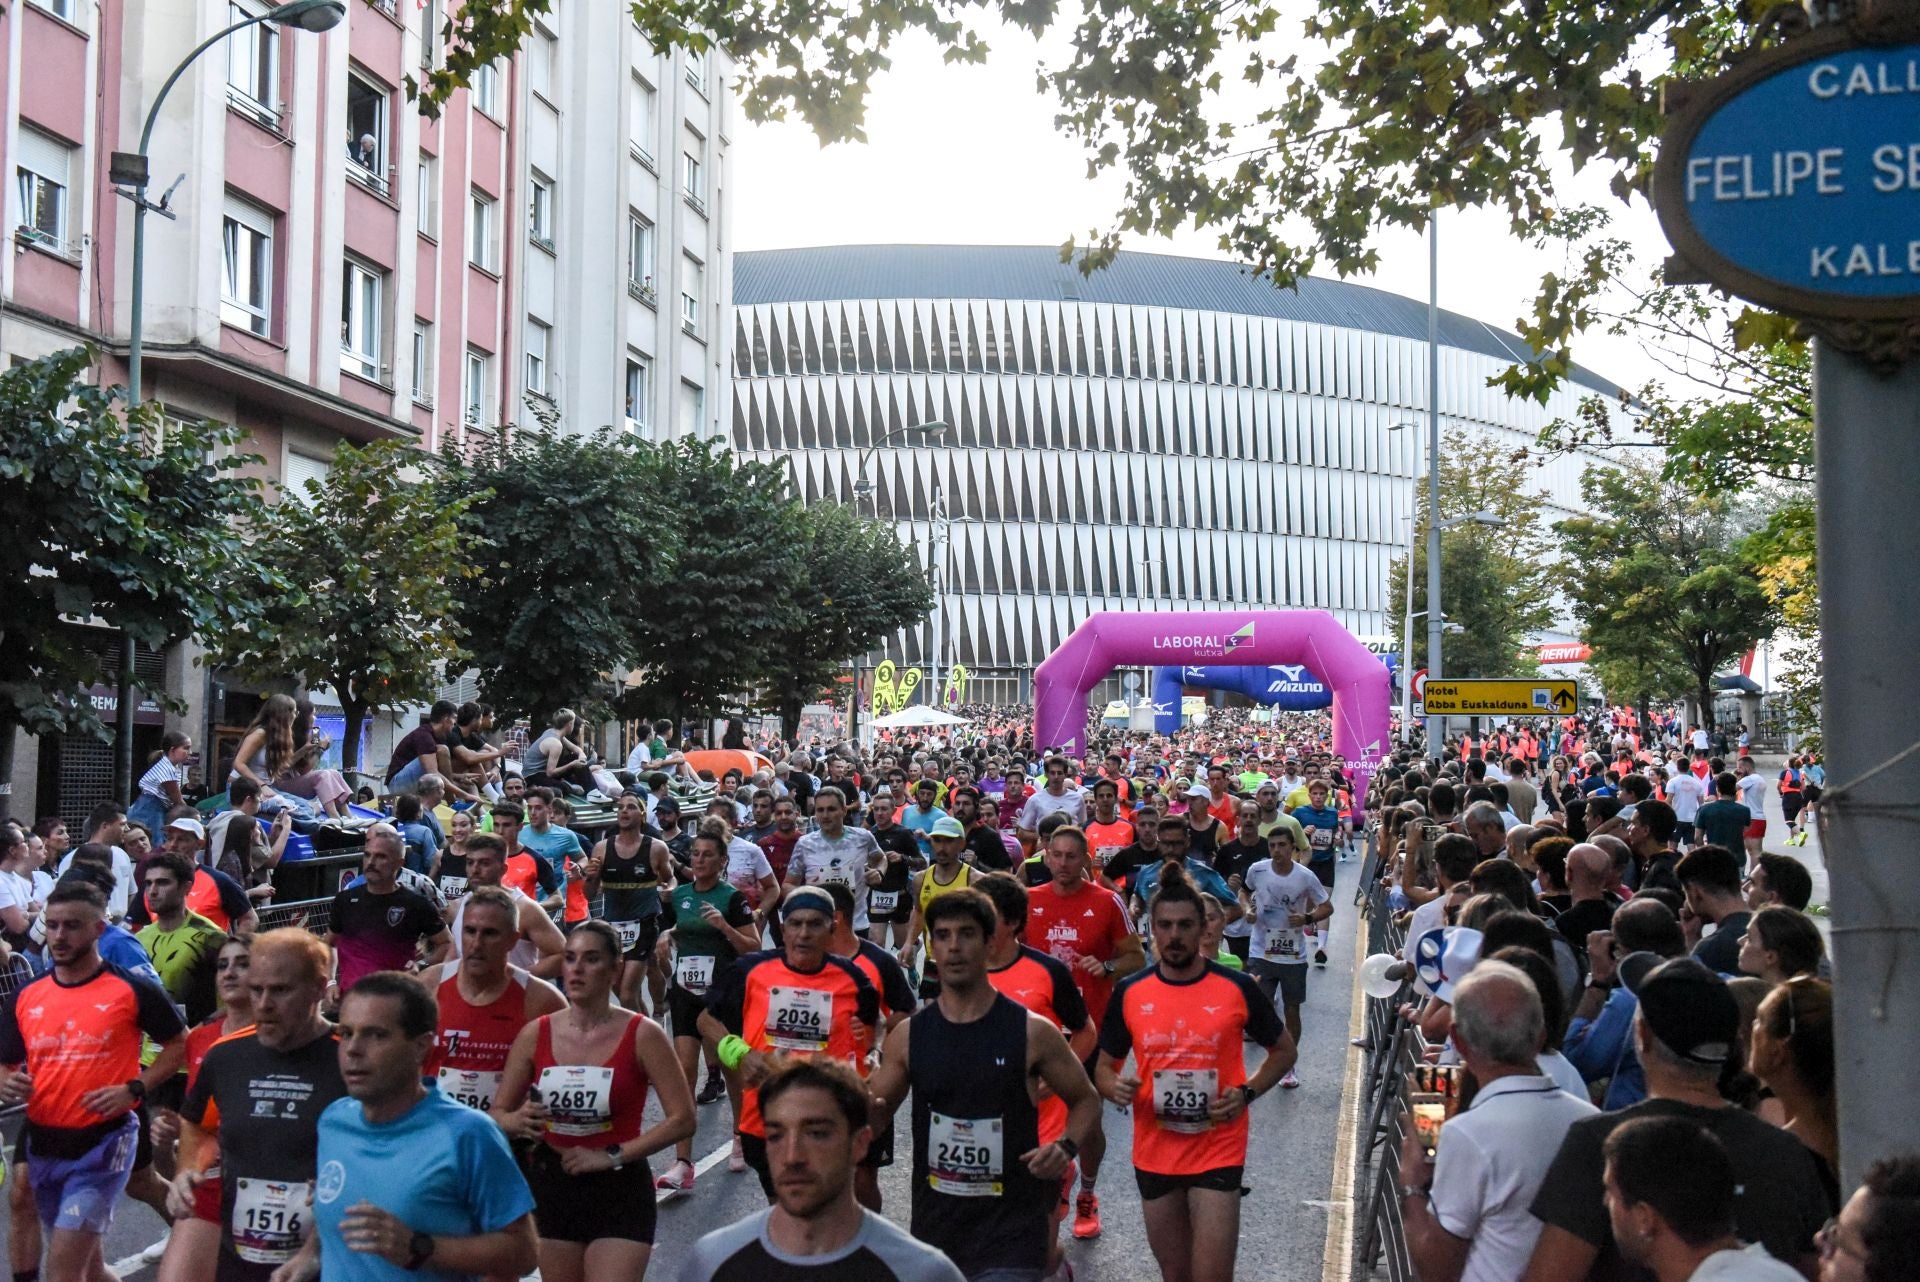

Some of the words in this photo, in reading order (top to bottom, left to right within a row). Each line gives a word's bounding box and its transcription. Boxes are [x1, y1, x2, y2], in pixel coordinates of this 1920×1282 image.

[1687, 148, 1844, 202] FELIPE
[1153, 636, 1222, 648] LABORAL
[1361, 642, 1401, 654] OLD
[1194, 649, 1223, 657] kutxa
[1537, 647, 1582, 660] NERVIT
[1427, 686, 1458, 696] Hotel
[875, 692, 883, 709] 3
[897, 693, 906, 708] 5
[1427, 700, 1456, 709] Abba
[1462, 700, 1528, 709] Euskalduna
[1343, 761, 1378, 769] ABORAL
[444, 886, 465, 896] 4109
[876, 896, 894, 904] 1978
[619, 930, 635, 939] 78
[1271, 939, 1294, 948] 1248
[682, 970, 705, 982] 1891
[778, 1008, 821, 1026] 2036
[549, 1091, 598, 1109] 2687
[1163, 1091, 1209, 1108] 2633
[938, 1142, 990, 1165] 2450
[246, 1208, 302, 1232] 1516
